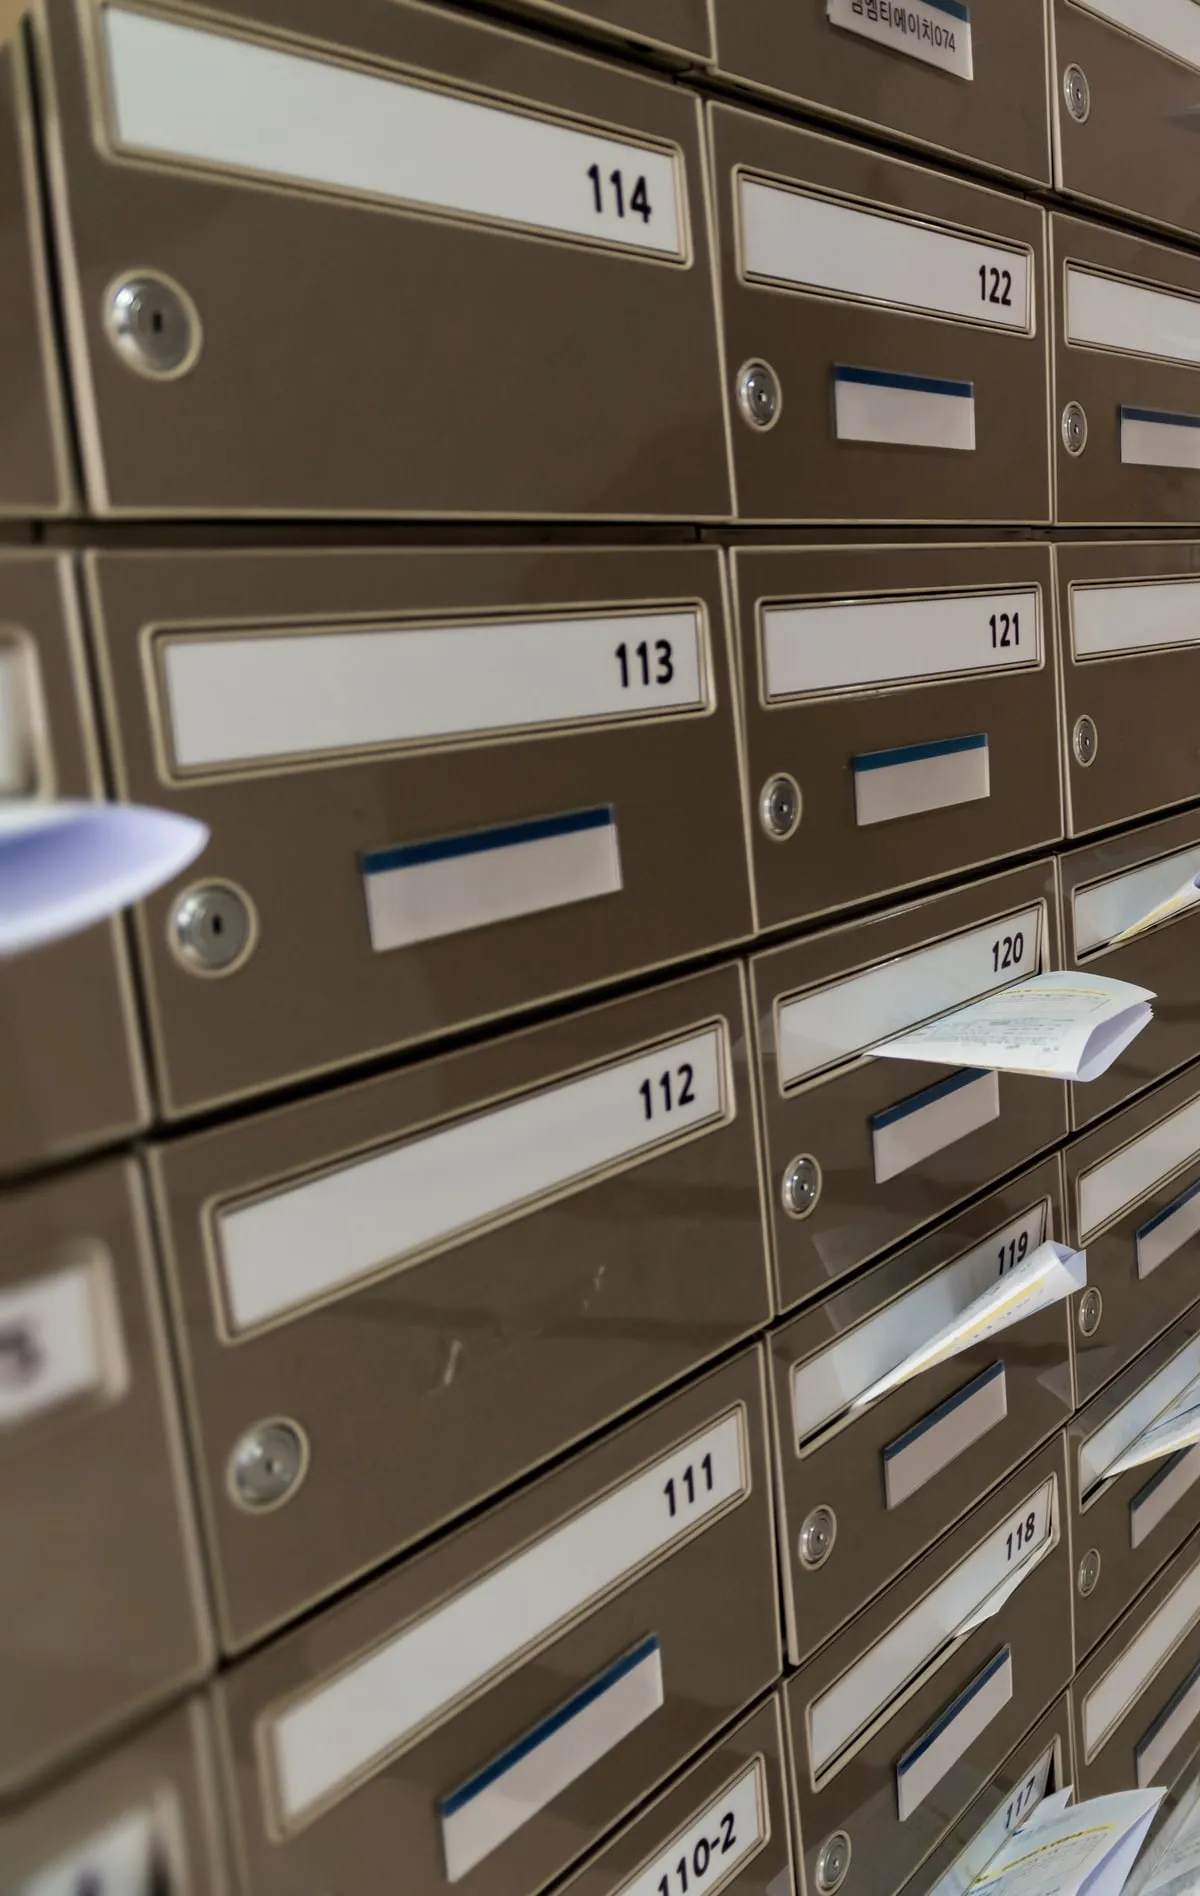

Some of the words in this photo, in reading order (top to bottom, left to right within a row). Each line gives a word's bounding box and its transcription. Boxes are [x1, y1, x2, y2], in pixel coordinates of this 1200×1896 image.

[586, 163, 653, 224] 114
[978, 264, 1012, 307] 122
[988, 611, 1020, 649] 121
[614, 638, 675, 689] 113
[991, 931, 1024, 973] 120
[638, 1063, 696, 1121] 112
[998, 1231, 1029, 1276] 119
[663, 1452, 714, 1518] 111
[1005, 1512, 1036, 1561] 118
[1004, 1775, 1036, 1830] 117
[657, 1811, 737, 1896] 110-2
